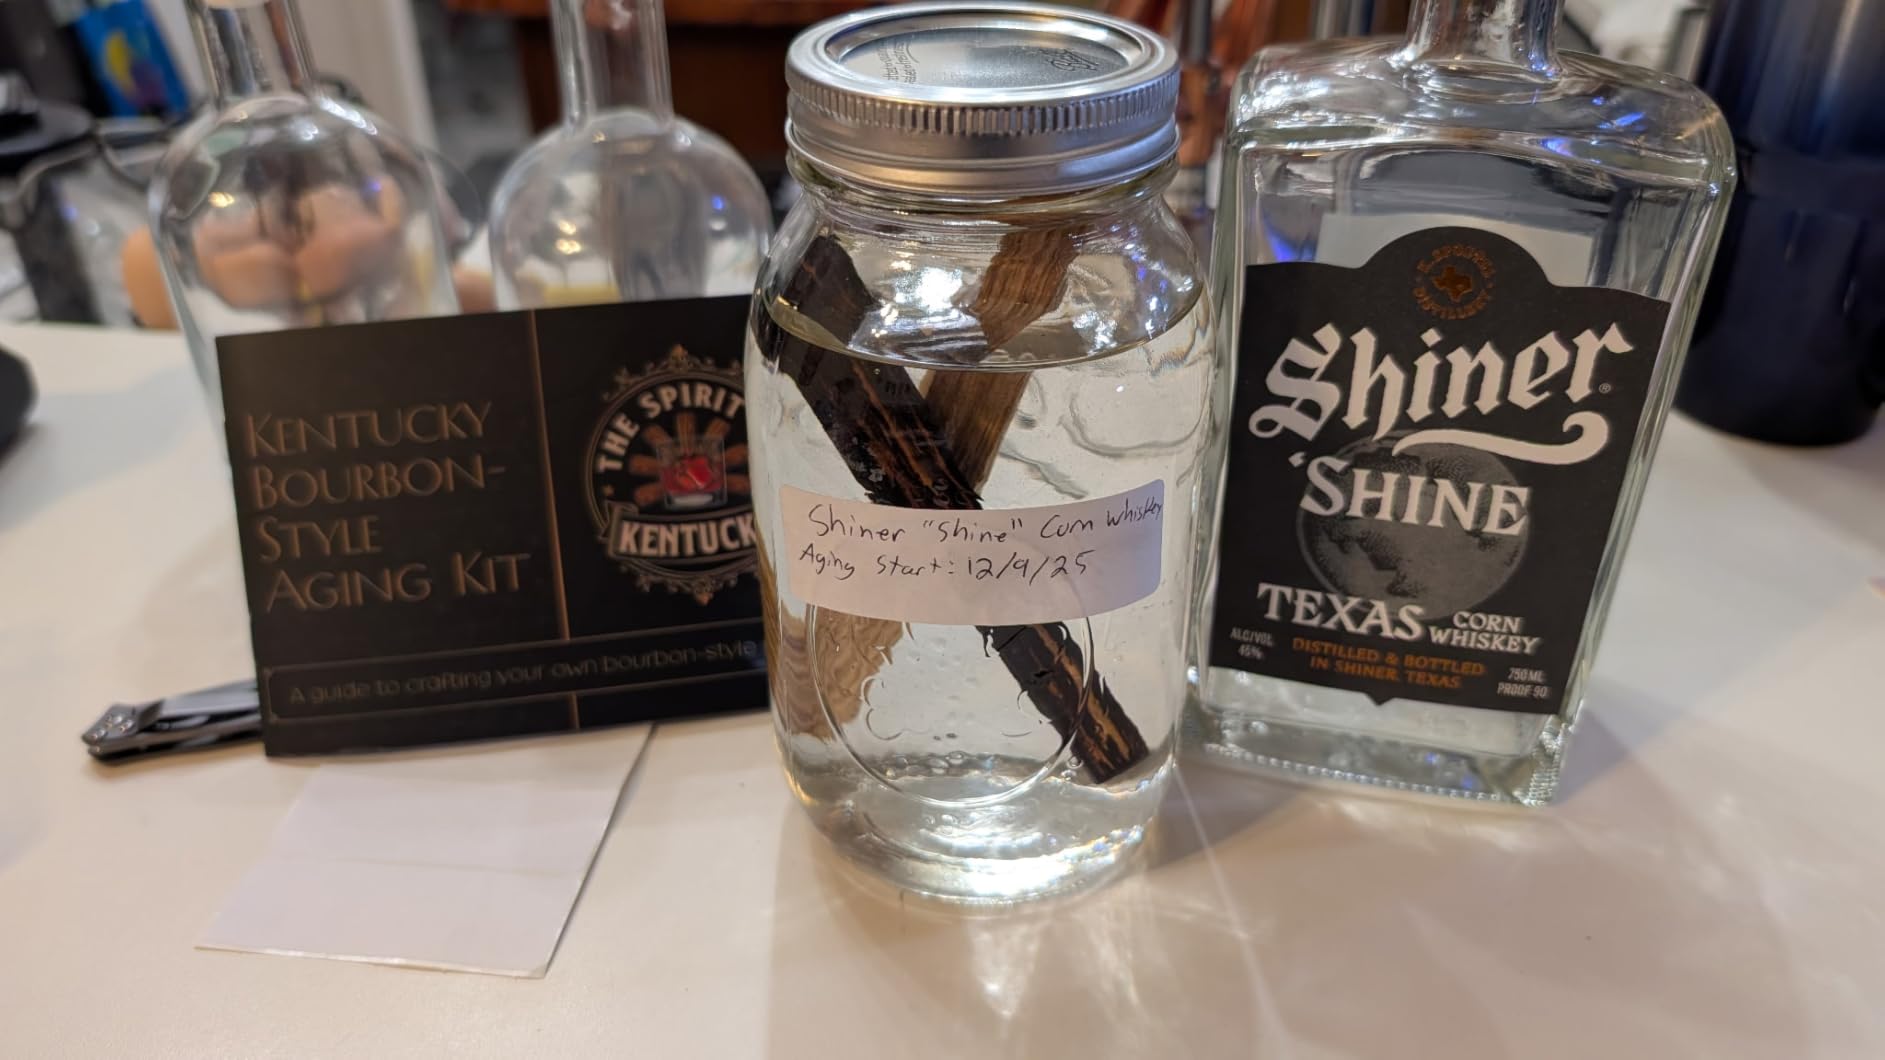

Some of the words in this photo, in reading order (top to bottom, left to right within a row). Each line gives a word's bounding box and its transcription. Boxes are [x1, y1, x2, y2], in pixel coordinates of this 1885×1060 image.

[1248, 322, 1635, 442] Shiner
[244, 401, 492, 457] KENTUCKY
[597, 412, 640, 474] THE
[252, 454, 507, 510] BOURBON-
[257, 515, 383, 563] STYLE
[808, 504, 906, 543] Shiner
[266, 562, 432, 613] AGING
[452, 551, 532, 597] KIT
[799, 542, 856, 579] Aging
[966, 549, 1096, 586] 12/9/25
[1257, 582, 1426, 643] TEXAS
[1452, 610, 1523, 635] CORN
[1292, 637, 1380, 662] DISTILLED
[1384, 652, 1399, 666] &
[1403, 654, 1486, 676] BOTTLED
[1429, 624, 1543, 656] WHISKEY
[290, 687, 306, 704] A
[312, 679, 371, 705] guide
[376, 678, 400, 697] to
[405, 668, 493, 695] crafting
[497, 661, 543, 686] your
[552, 657, 599, 679] own
[1310, 655, 1330, 670] IN
[1406, 669, 1463, 689] TEXAS
[1497, 682, 1532, 697] PROOF
[1533, 685, 1550, 699] 90
